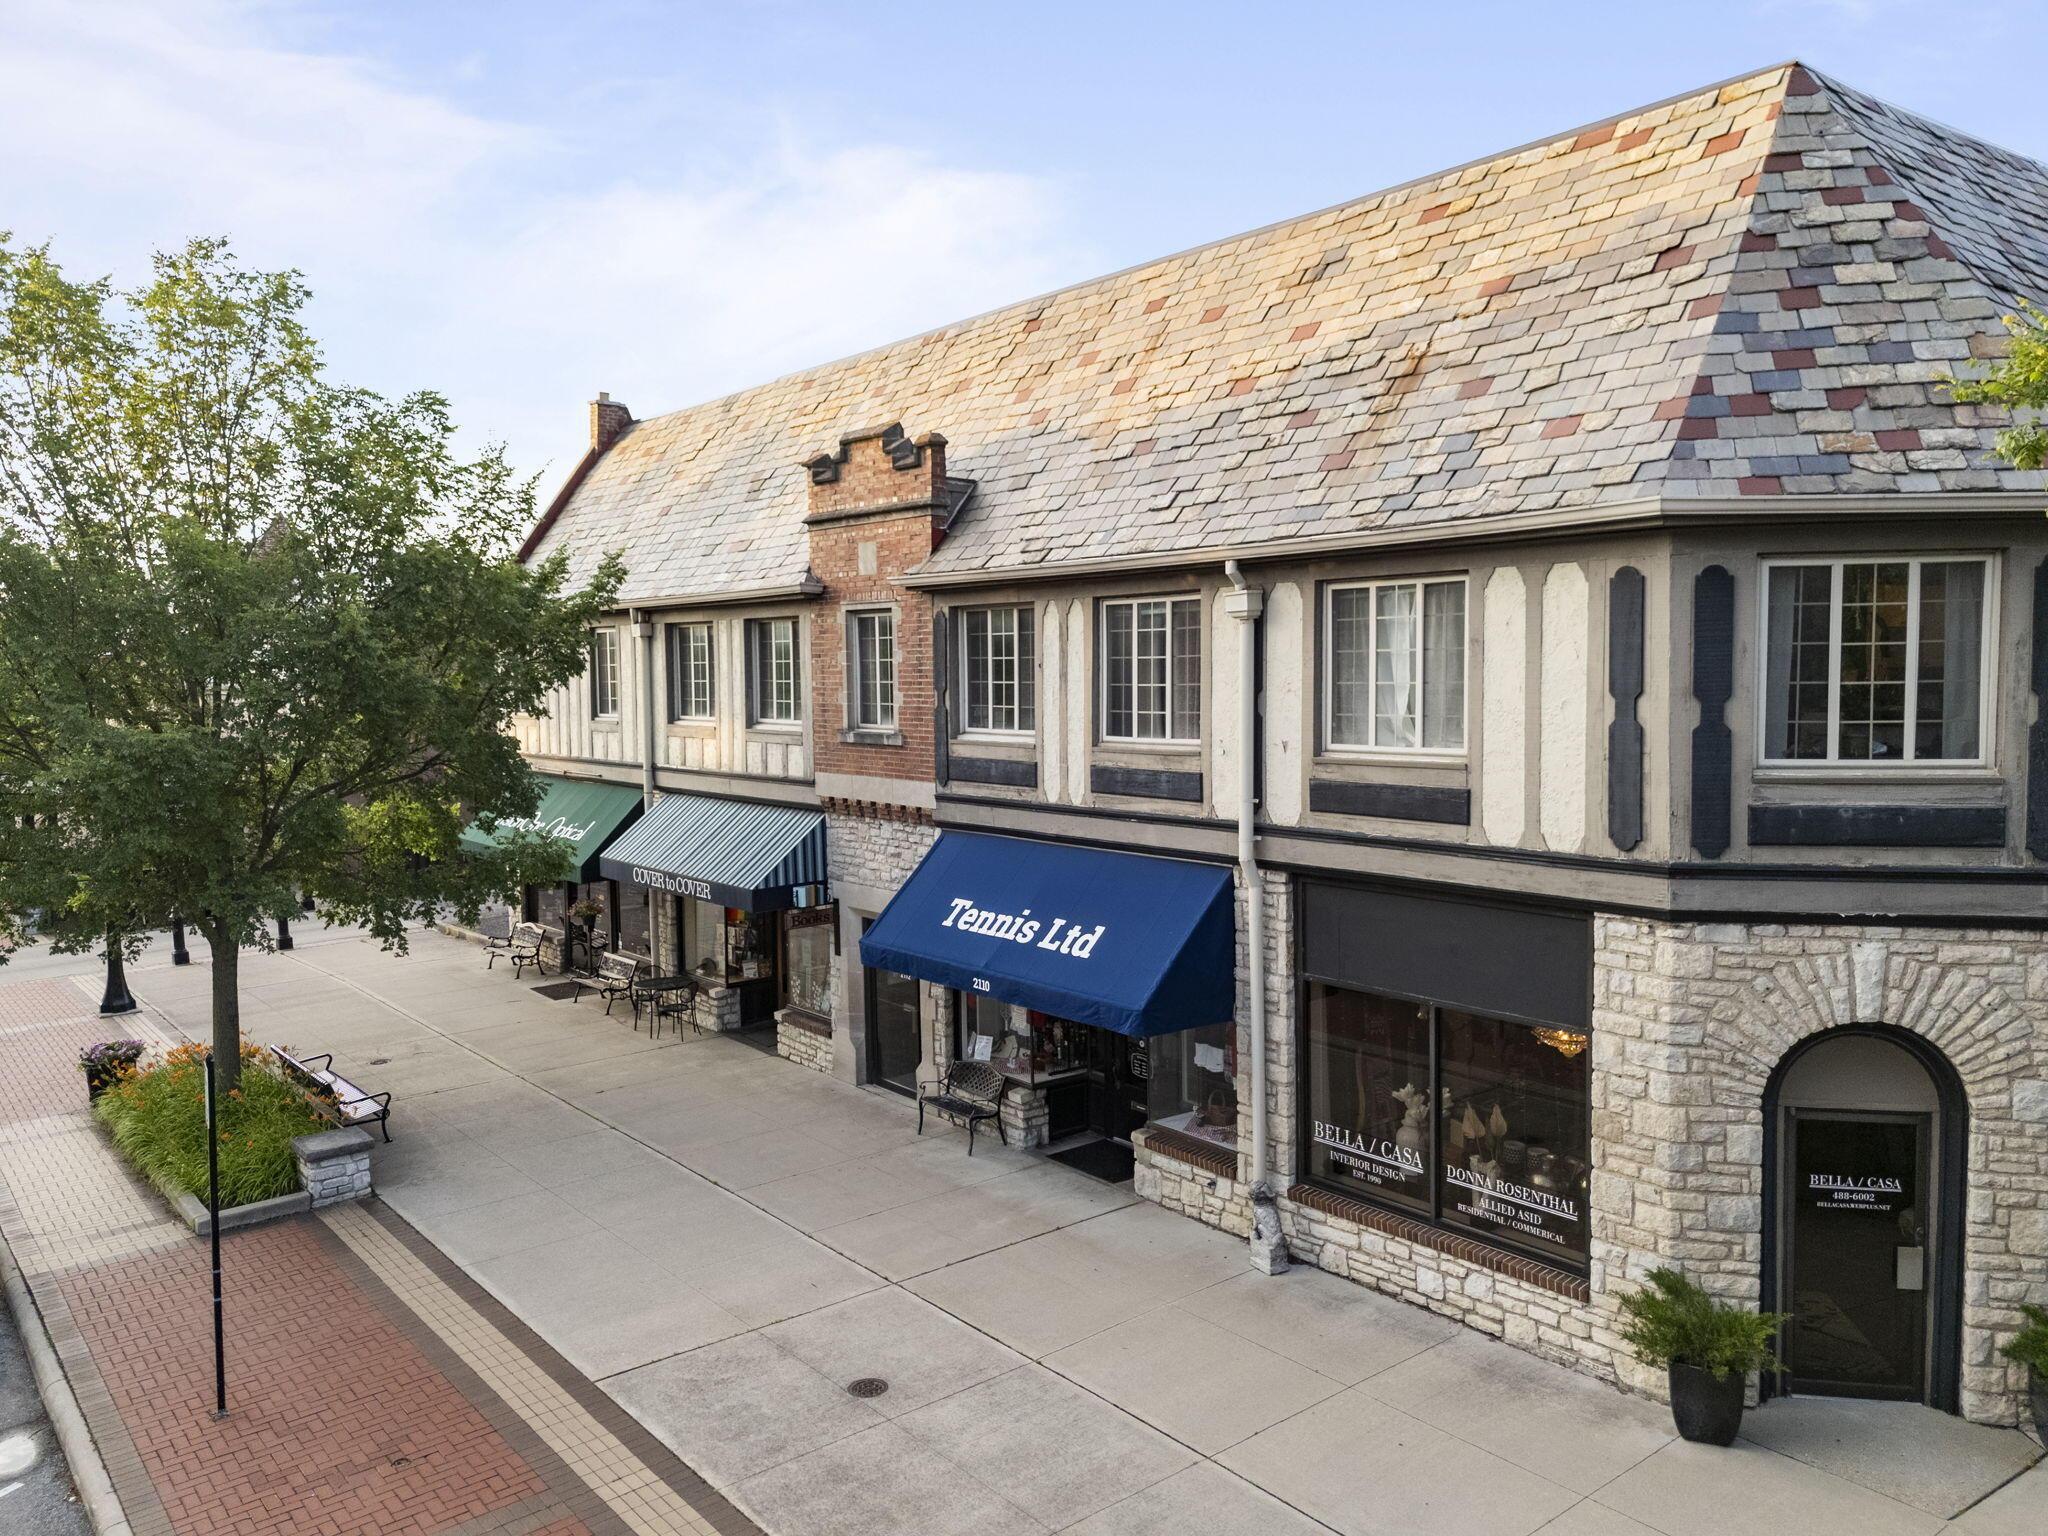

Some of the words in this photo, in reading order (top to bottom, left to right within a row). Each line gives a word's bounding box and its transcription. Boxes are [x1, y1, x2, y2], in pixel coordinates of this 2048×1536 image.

[633, 867, 665, 889] COVER
[665, 875, 675, 891] to
[676, 877, 711, 900] COVER
[941, 898, 1041, 944] Tennis
[1037, 918, 1106, 959] Ltd
[972, 977, 990, 992] 2110
[1314, 1120, 1365, 1151] BELLA
[1381, 1141, 1423, 1168] CASA
[1330, 1150, 1370, 1173] INTERIOR
[1372, 1163, 1406, 1182] DESIGN
[1446, 1164, 1492, 1190] DONNA
[1496, 1179, 1578, 1216] ROSENTHAL
[1809, 1174, 1854, 1187] BELLA
[1867, 1177, 1901, 1189] CASA
[1832, 1191, 1875, 1201] 488-6002
[1458, 1202, 1506, 1226] RESIDENTIAL
[1479, 1197, 1515, 1217] ALLIED
[1517, 1209, 1541, 1225] ASID
